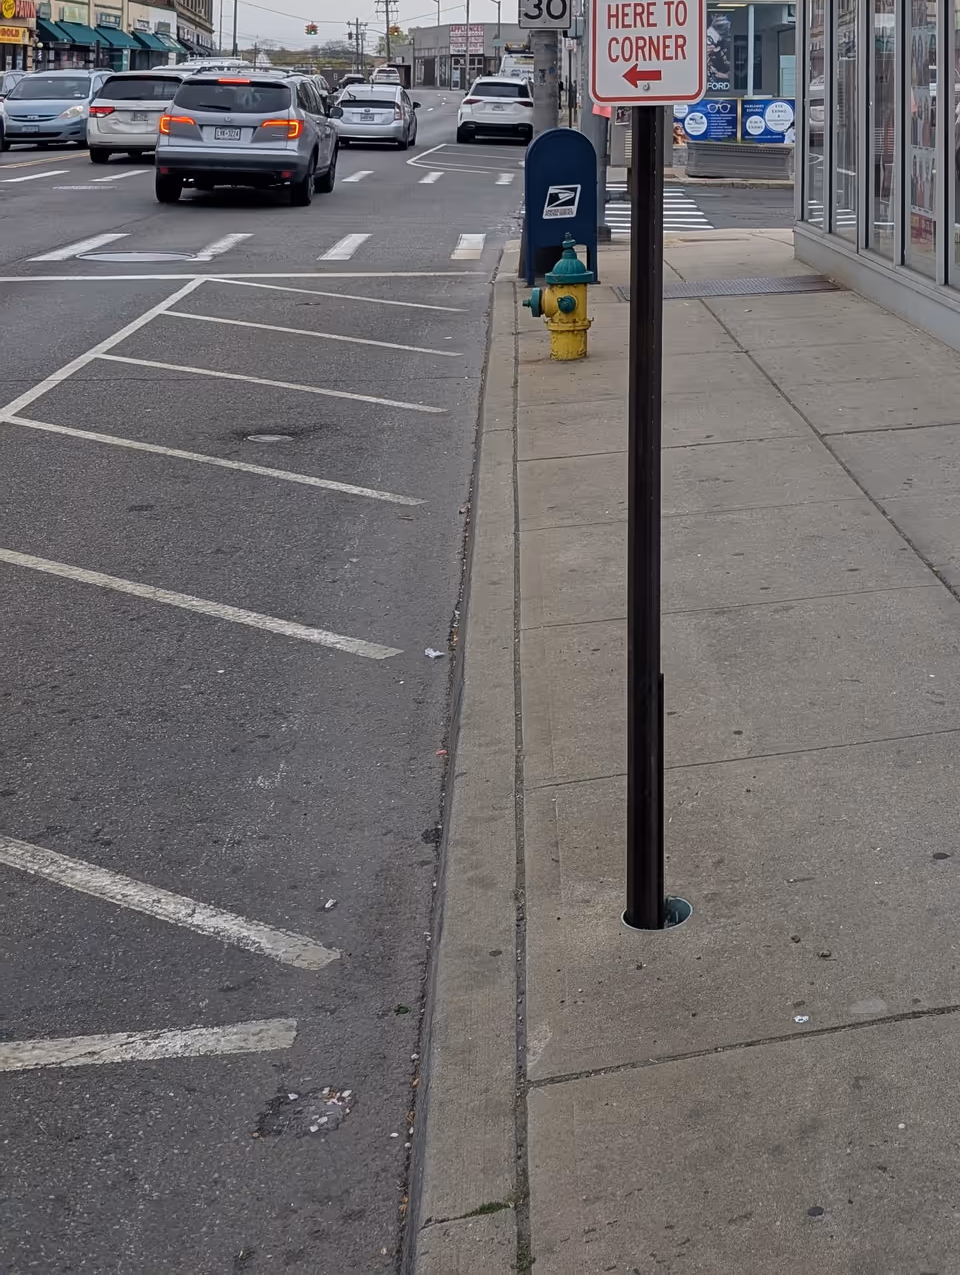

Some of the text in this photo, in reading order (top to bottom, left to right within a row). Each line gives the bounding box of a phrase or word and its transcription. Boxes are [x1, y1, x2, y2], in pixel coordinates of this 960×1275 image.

[16, 0, 36, 18] PAWN
[607, 0, 688, 31] HERE TO
[608, 34, 687, 64] CORNER
[707, 81, 730, 91] FORD
